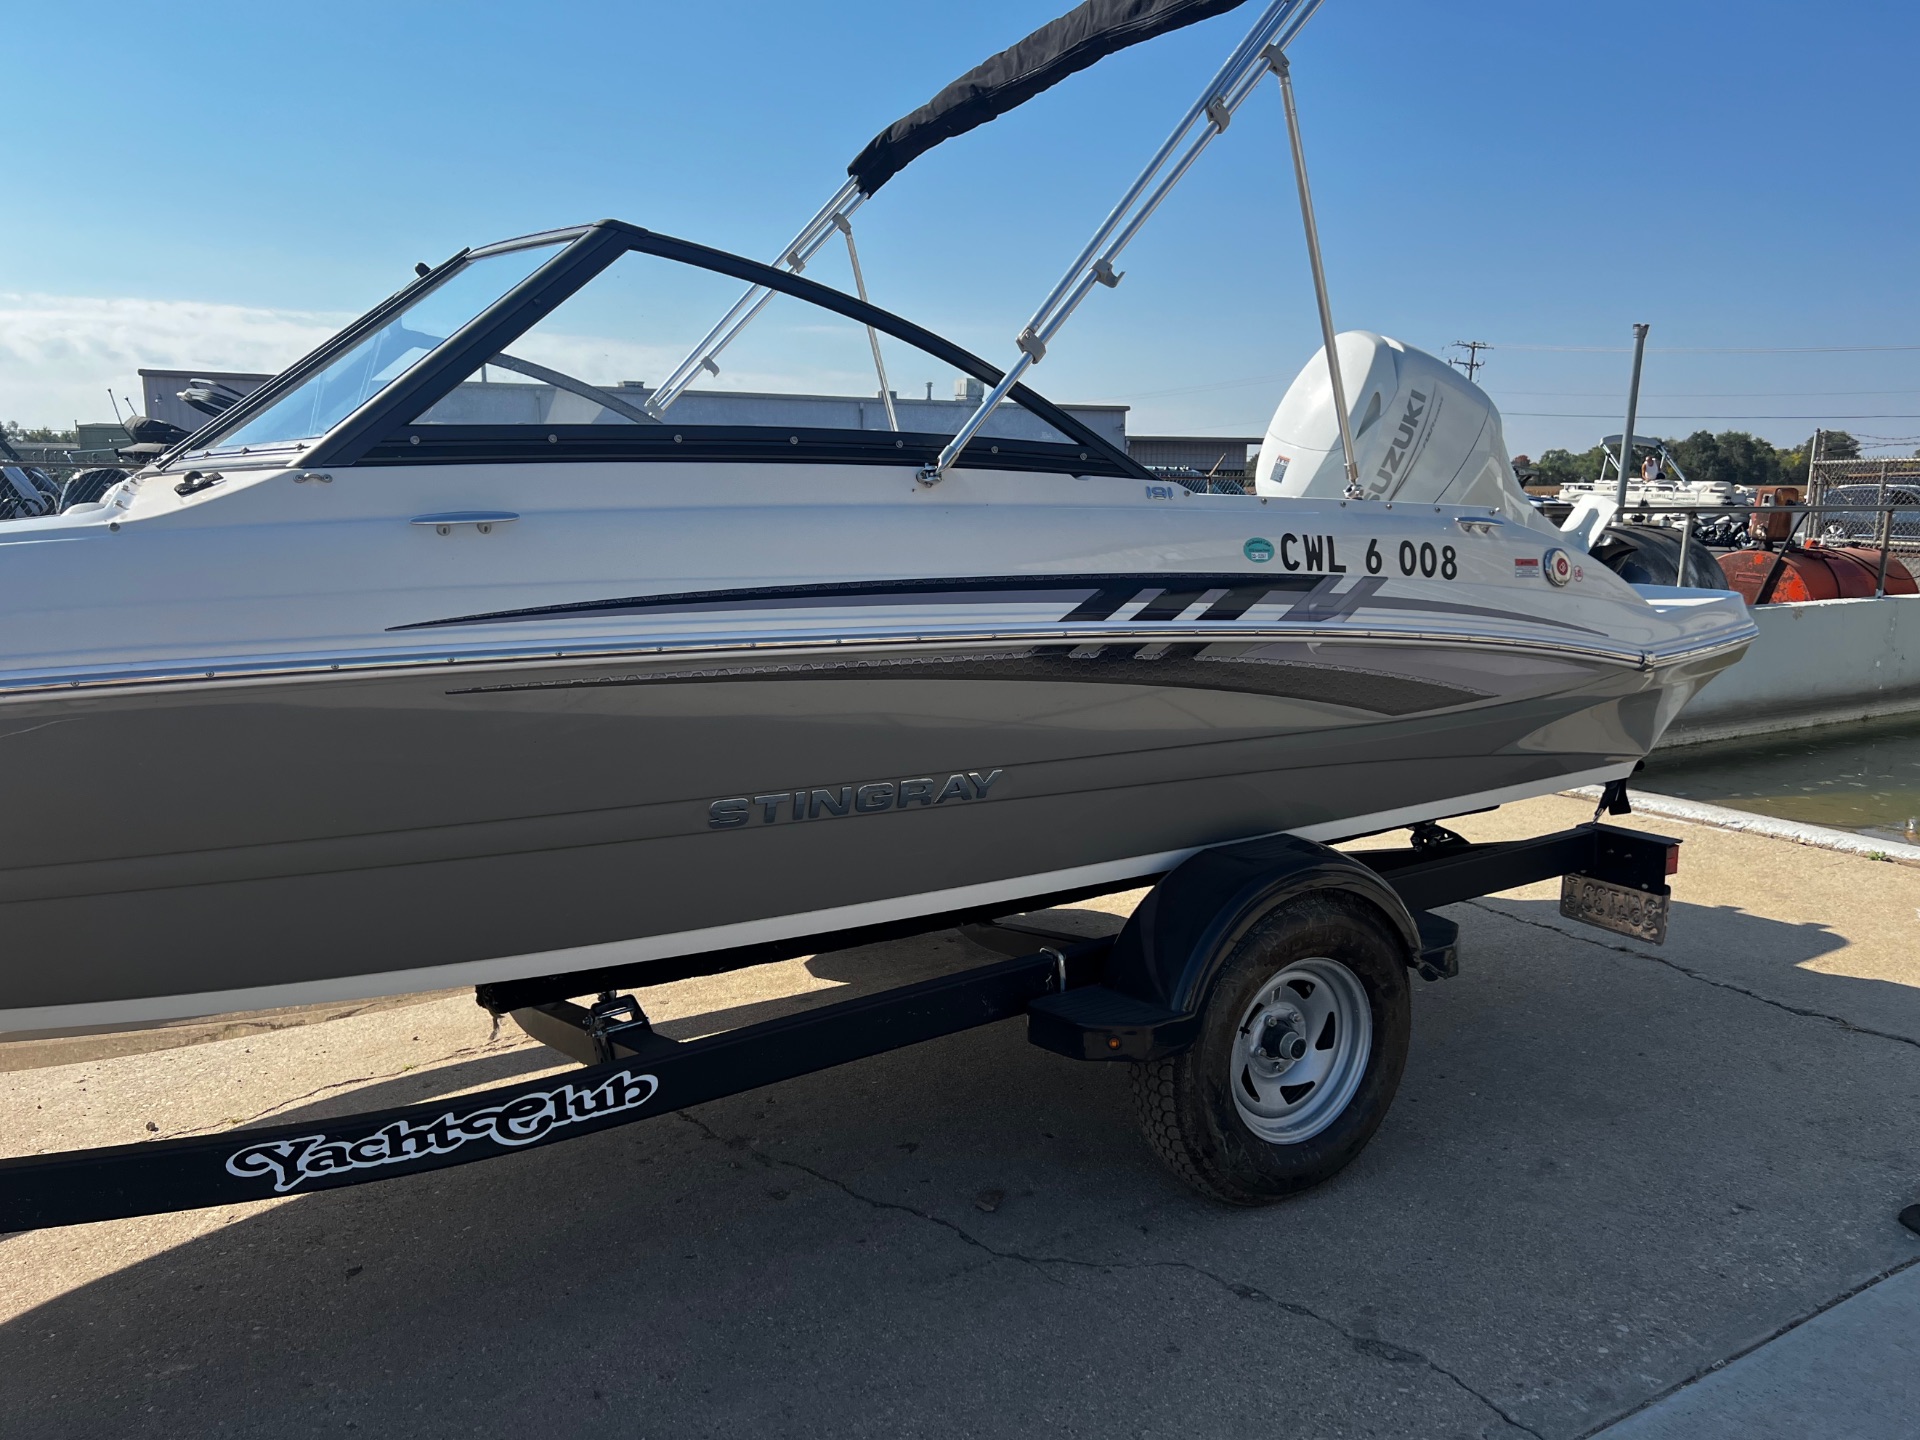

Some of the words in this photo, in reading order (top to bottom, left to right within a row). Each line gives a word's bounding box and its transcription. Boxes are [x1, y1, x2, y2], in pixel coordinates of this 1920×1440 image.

[1281, 533, 1346, 573] CWL
[1365, 538, 1383, 575] 6
[1399, 540, 1457, 580] 008
[708, 769, 1003, 830] STINGRAY
